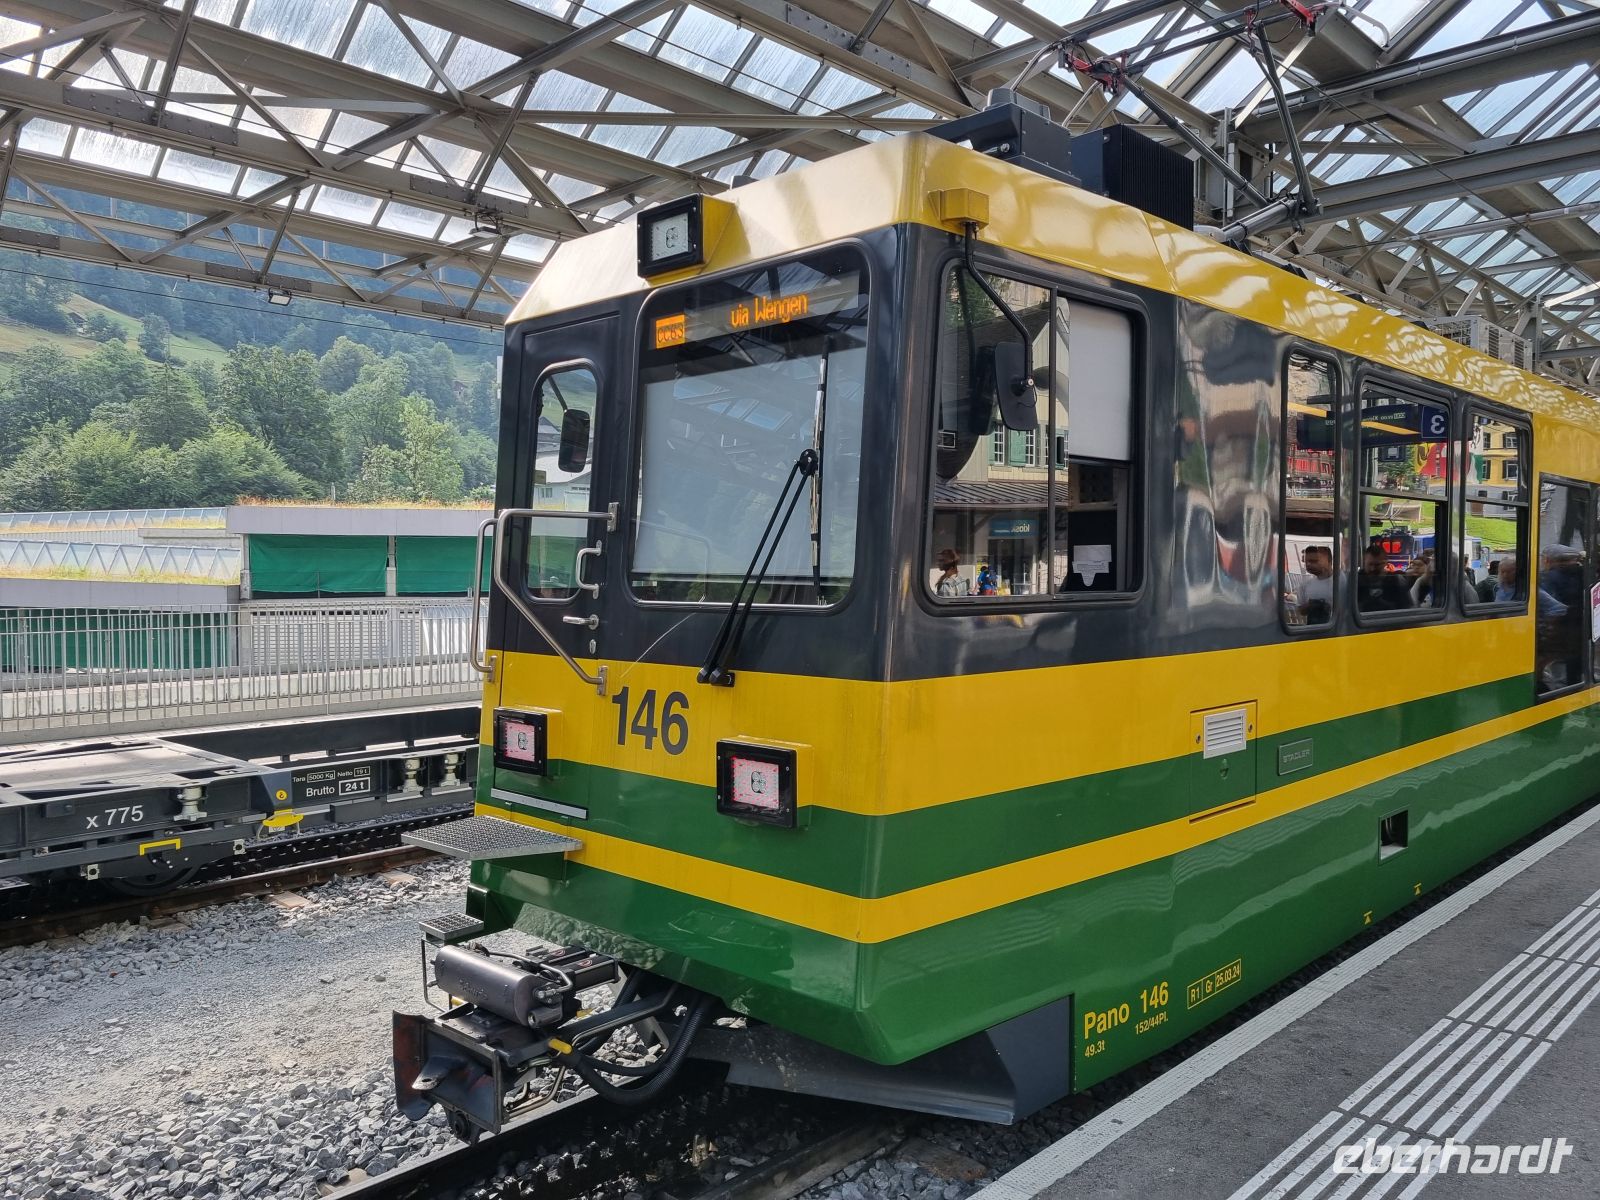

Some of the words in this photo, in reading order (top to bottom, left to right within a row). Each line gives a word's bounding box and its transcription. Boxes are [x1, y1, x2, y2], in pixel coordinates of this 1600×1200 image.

[731, 303, 749, 328] via
[755, 293, 809, 324] Wengen
[612, 686, 690, 756] 146
[306, 786, 335, 797] Brutto
[345, 782, 358, 792] 24
[104, 805, 144, 826] 775
[1215, 963, 1240, 988] 25.03.24
[1084, 1003, 1130, 1039] Pano
[1140, 981, 1169, 1014] 146
[1084, 1039, 1105, 1058] 49.3t
